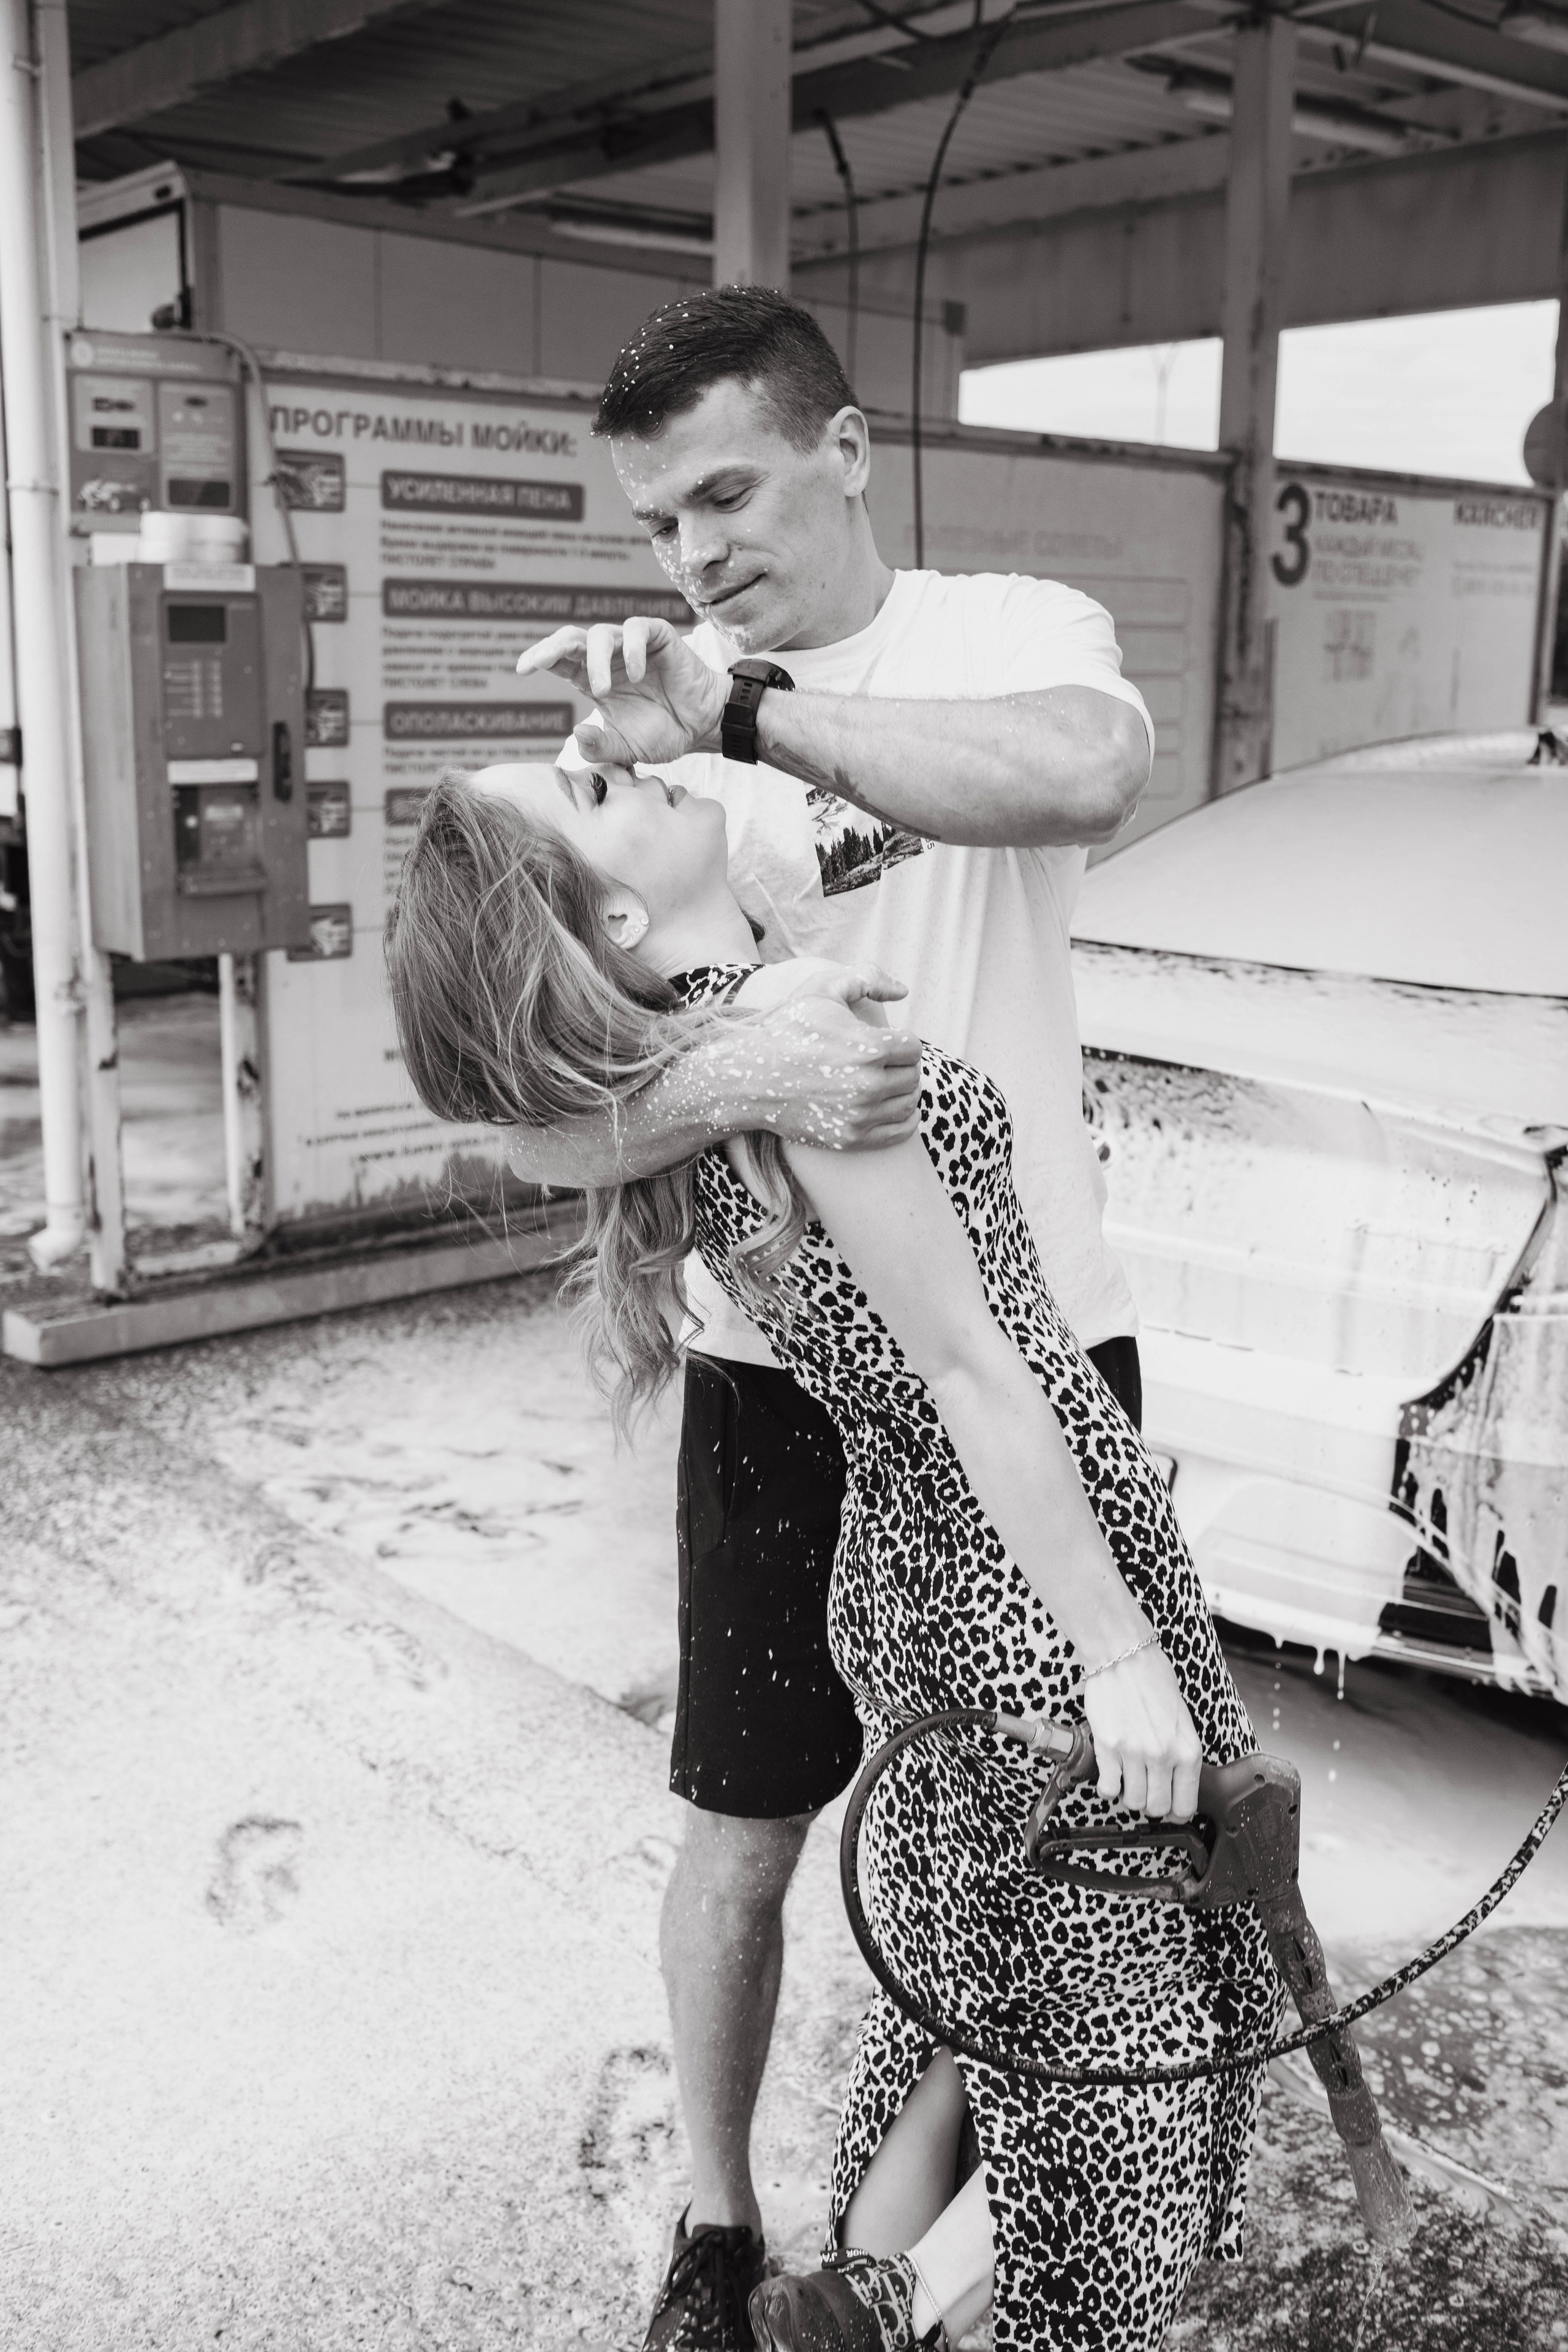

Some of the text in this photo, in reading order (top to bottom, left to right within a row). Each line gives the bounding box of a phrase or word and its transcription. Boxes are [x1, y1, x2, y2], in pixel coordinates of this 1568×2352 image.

[270, 405, 578, 457] ПРОГРАММЫ МОЙКИ:
[388, 476, 572, 510] УСИЛЕННАЯ ПЕНА
[1316, 491, 1399, 525] ТОВАРА
[1270, 482, 1310, 588] 3
[390, 586, 466, 611] МОЙКА
